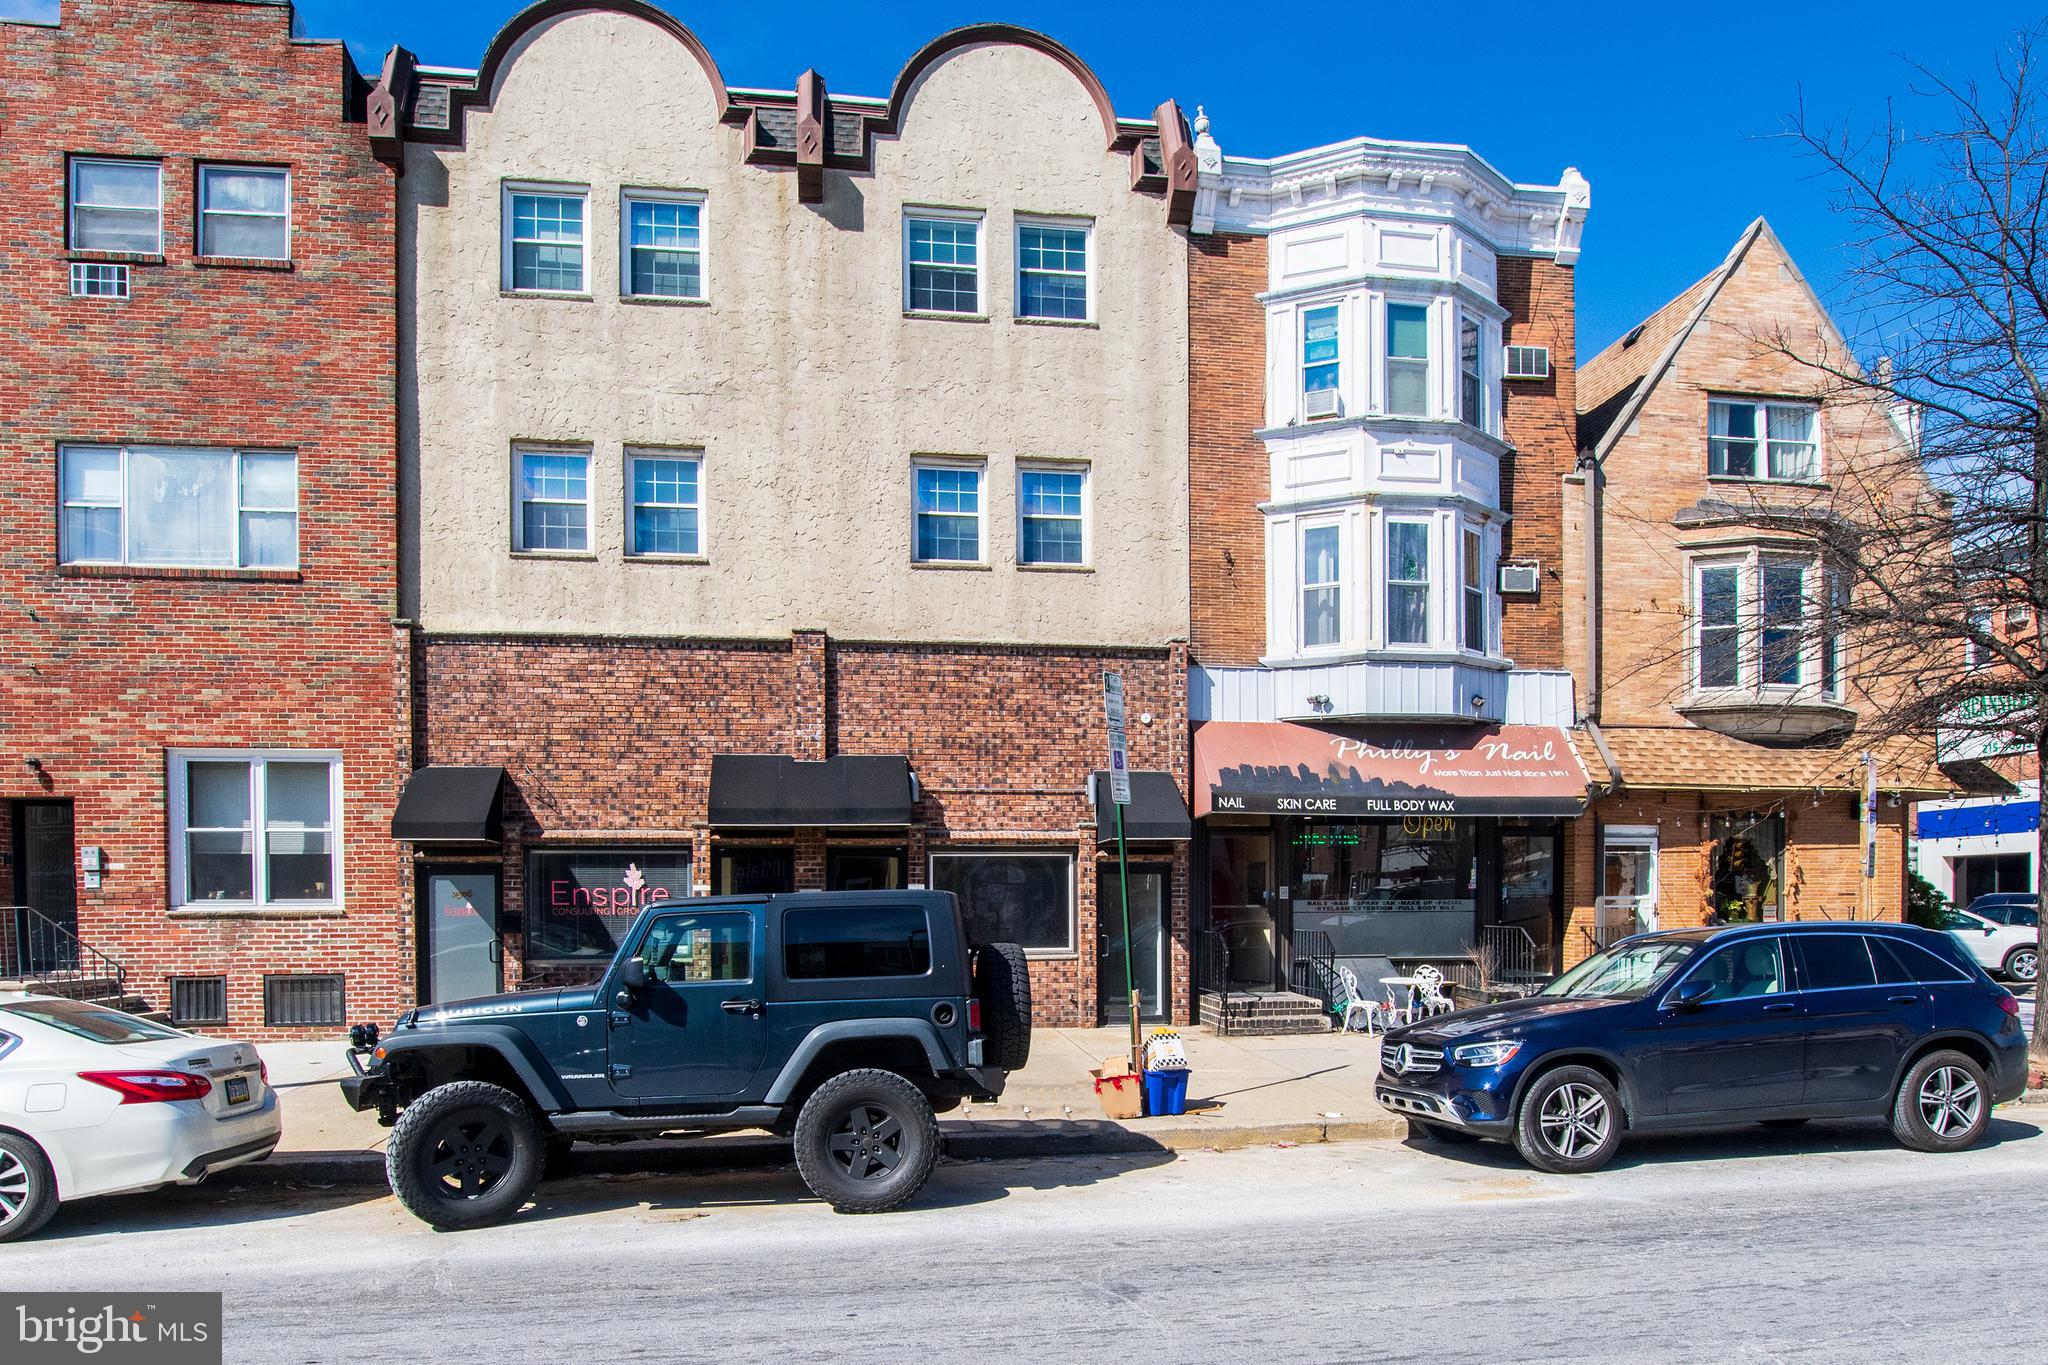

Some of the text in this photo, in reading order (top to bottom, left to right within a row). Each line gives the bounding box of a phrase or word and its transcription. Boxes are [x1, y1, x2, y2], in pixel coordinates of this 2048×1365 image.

[1330, 737, 1557, 774] Philly's Nail
[1433, 769, 1458, 777] More
[1458, 769, 1482, 777] Than
[1485, 769, 1502, 777] Just
[1218, 797, 1455, 811] NAIL SKIN CARE FULL BODY WAX
[1403, 815, 1456, 838] Open
[551, 873, 669, 914] Enspire
[552, 907, 611, 917] CONSULTING
[435, 1005, 522, 1019] RUBICON
